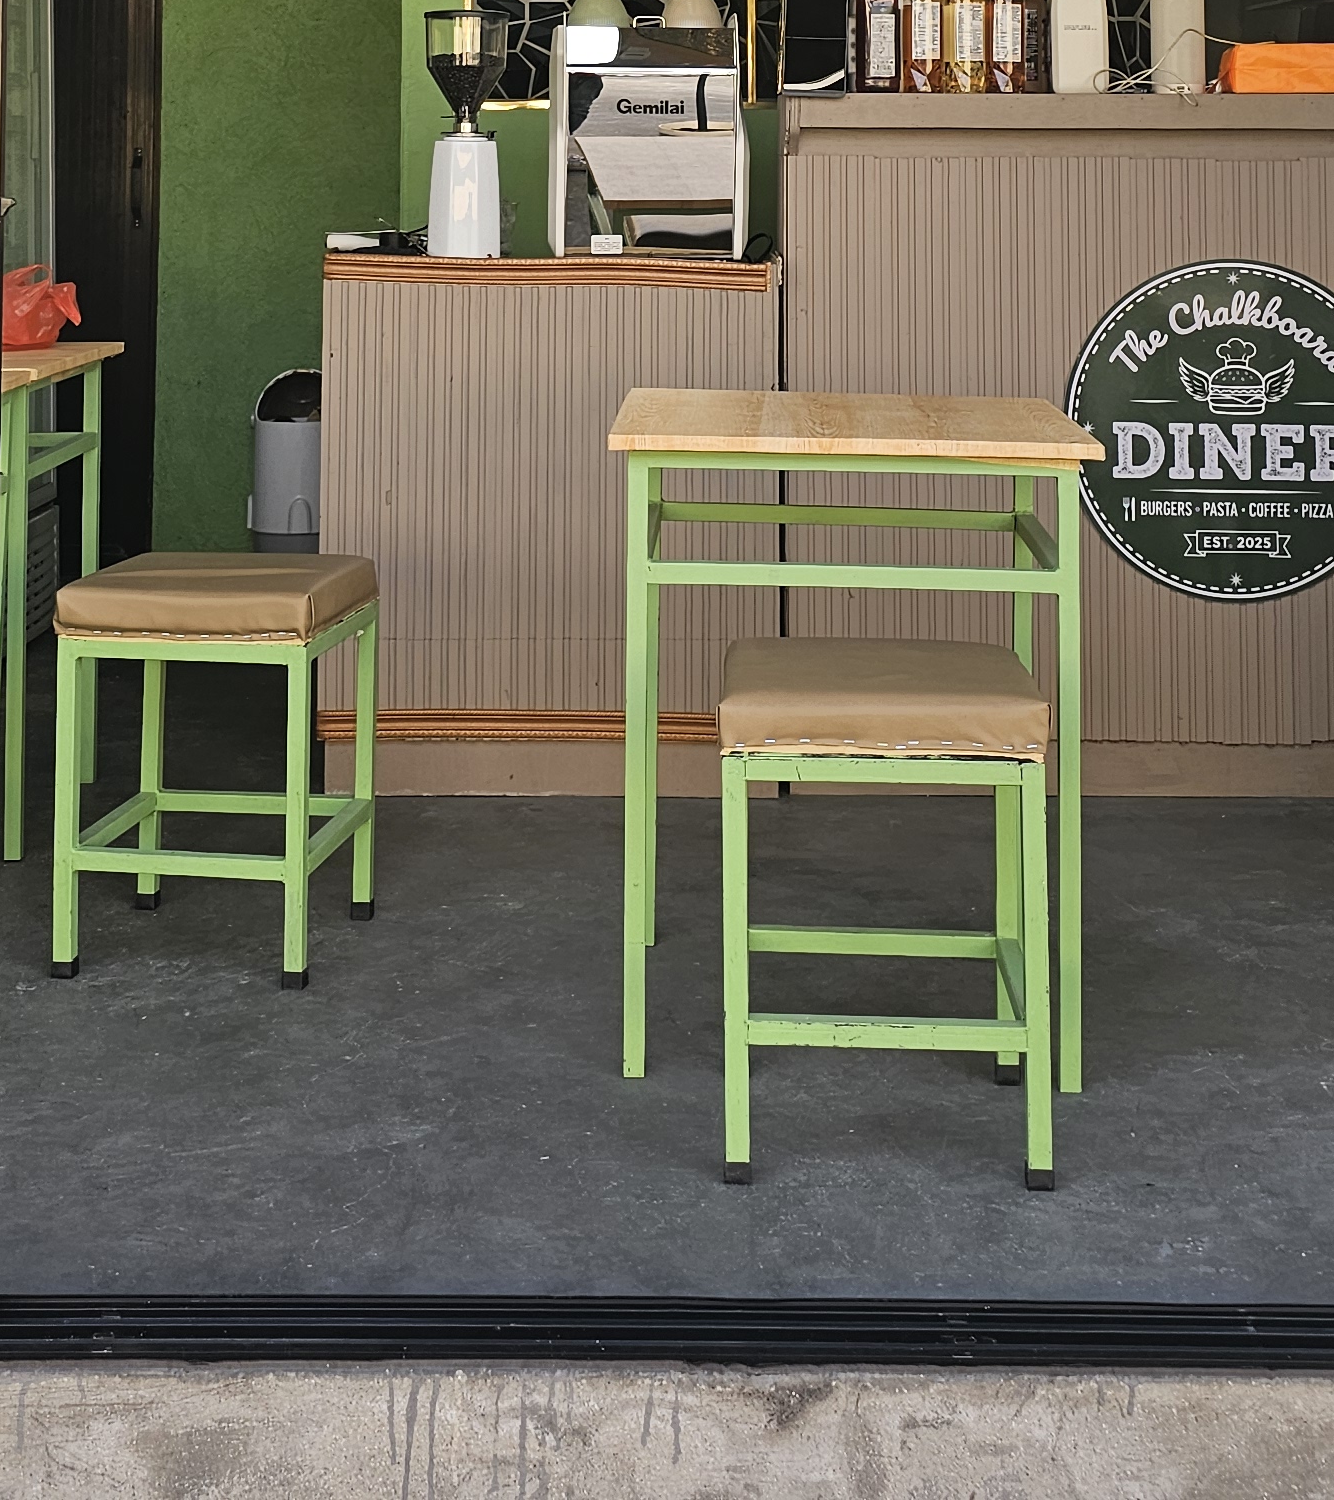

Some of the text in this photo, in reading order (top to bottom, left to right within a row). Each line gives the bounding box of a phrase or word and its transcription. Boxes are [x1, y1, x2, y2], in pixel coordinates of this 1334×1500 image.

[616, 98, 685, 115] Gemilai
[1108, 329, 1169, 373] The
[1140, 500, 1334, 519] BURGERS PASTA COFFEE PIZZA
[1203, 536, 1272, 549] EST. 2025
